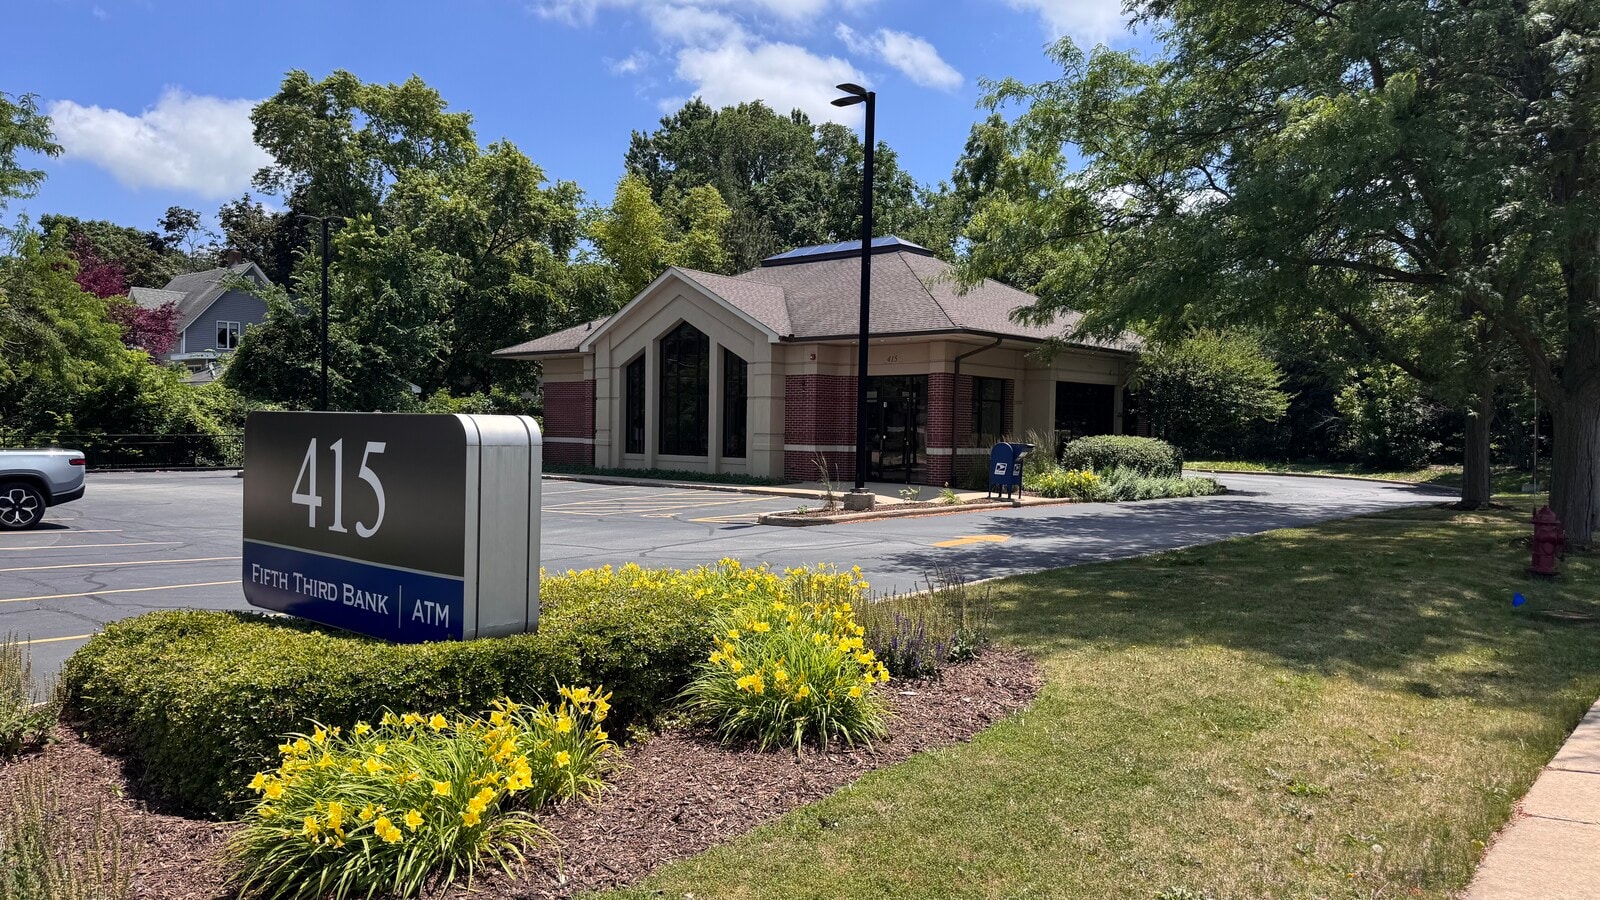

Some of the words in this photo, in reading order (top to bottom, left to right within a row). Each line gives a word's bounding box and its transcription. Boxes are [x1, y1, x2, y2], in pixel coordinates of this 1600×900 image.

[292, 437, 387, 538] 415
[251, 563, 289, 590] FIFTH
[292, 572, 338, 602] THIRD
[342, 583, 389, 615] BANK
[411, 599, 450, 628] ATM
